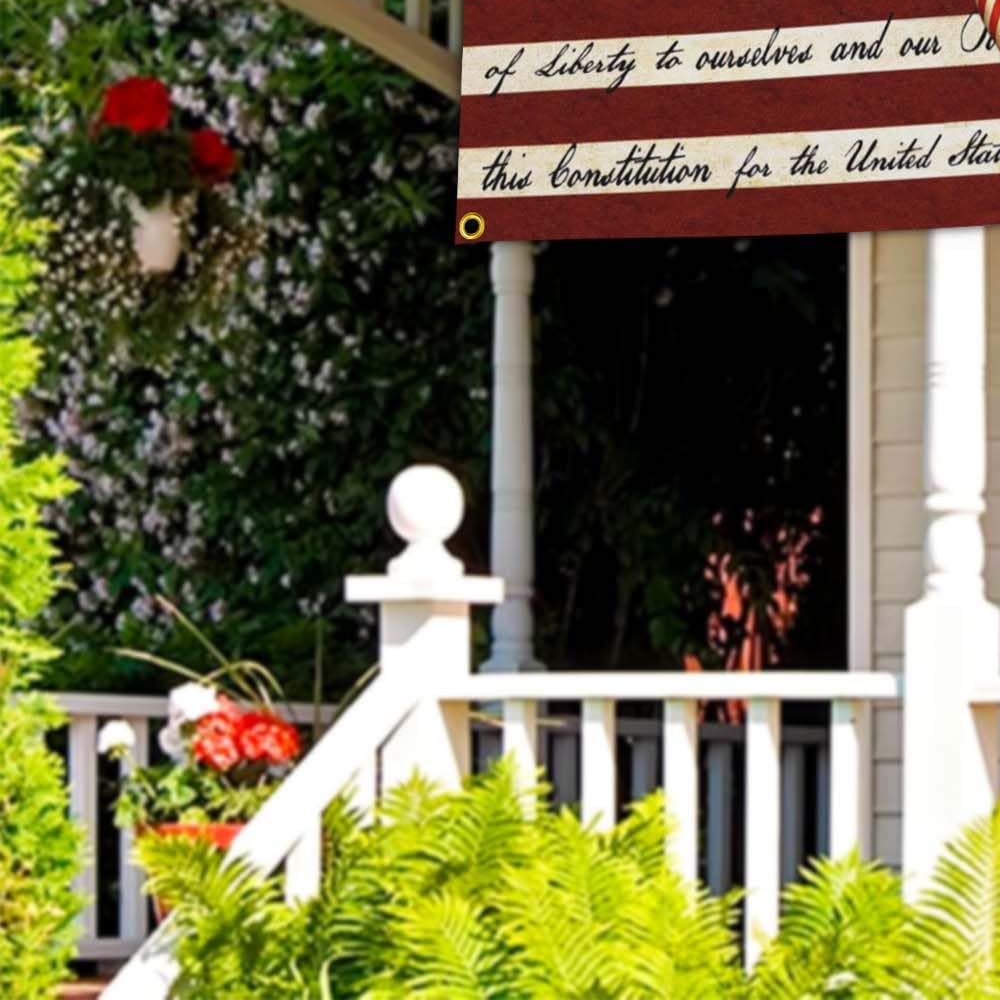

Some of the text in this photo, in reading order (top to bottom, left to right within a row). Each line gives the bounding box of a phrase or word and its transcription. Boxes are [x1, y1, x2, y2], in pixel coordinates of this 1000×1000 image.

[484, 48, 525, 97] of
[535, 42, 638, 93] Liberty
[655, 40, 683, 70] to
[695, 25, 813, 70] ourselves
[831, 12, 895, 61] and
[900, 34, 942, 56] our
[481, 151, 534, 192] this
[549, 142, 713, 189] Constitution
[726, 146, 773, 200] for
[789, 144, 828, 176] the
[845, 134, 943, 173] United
